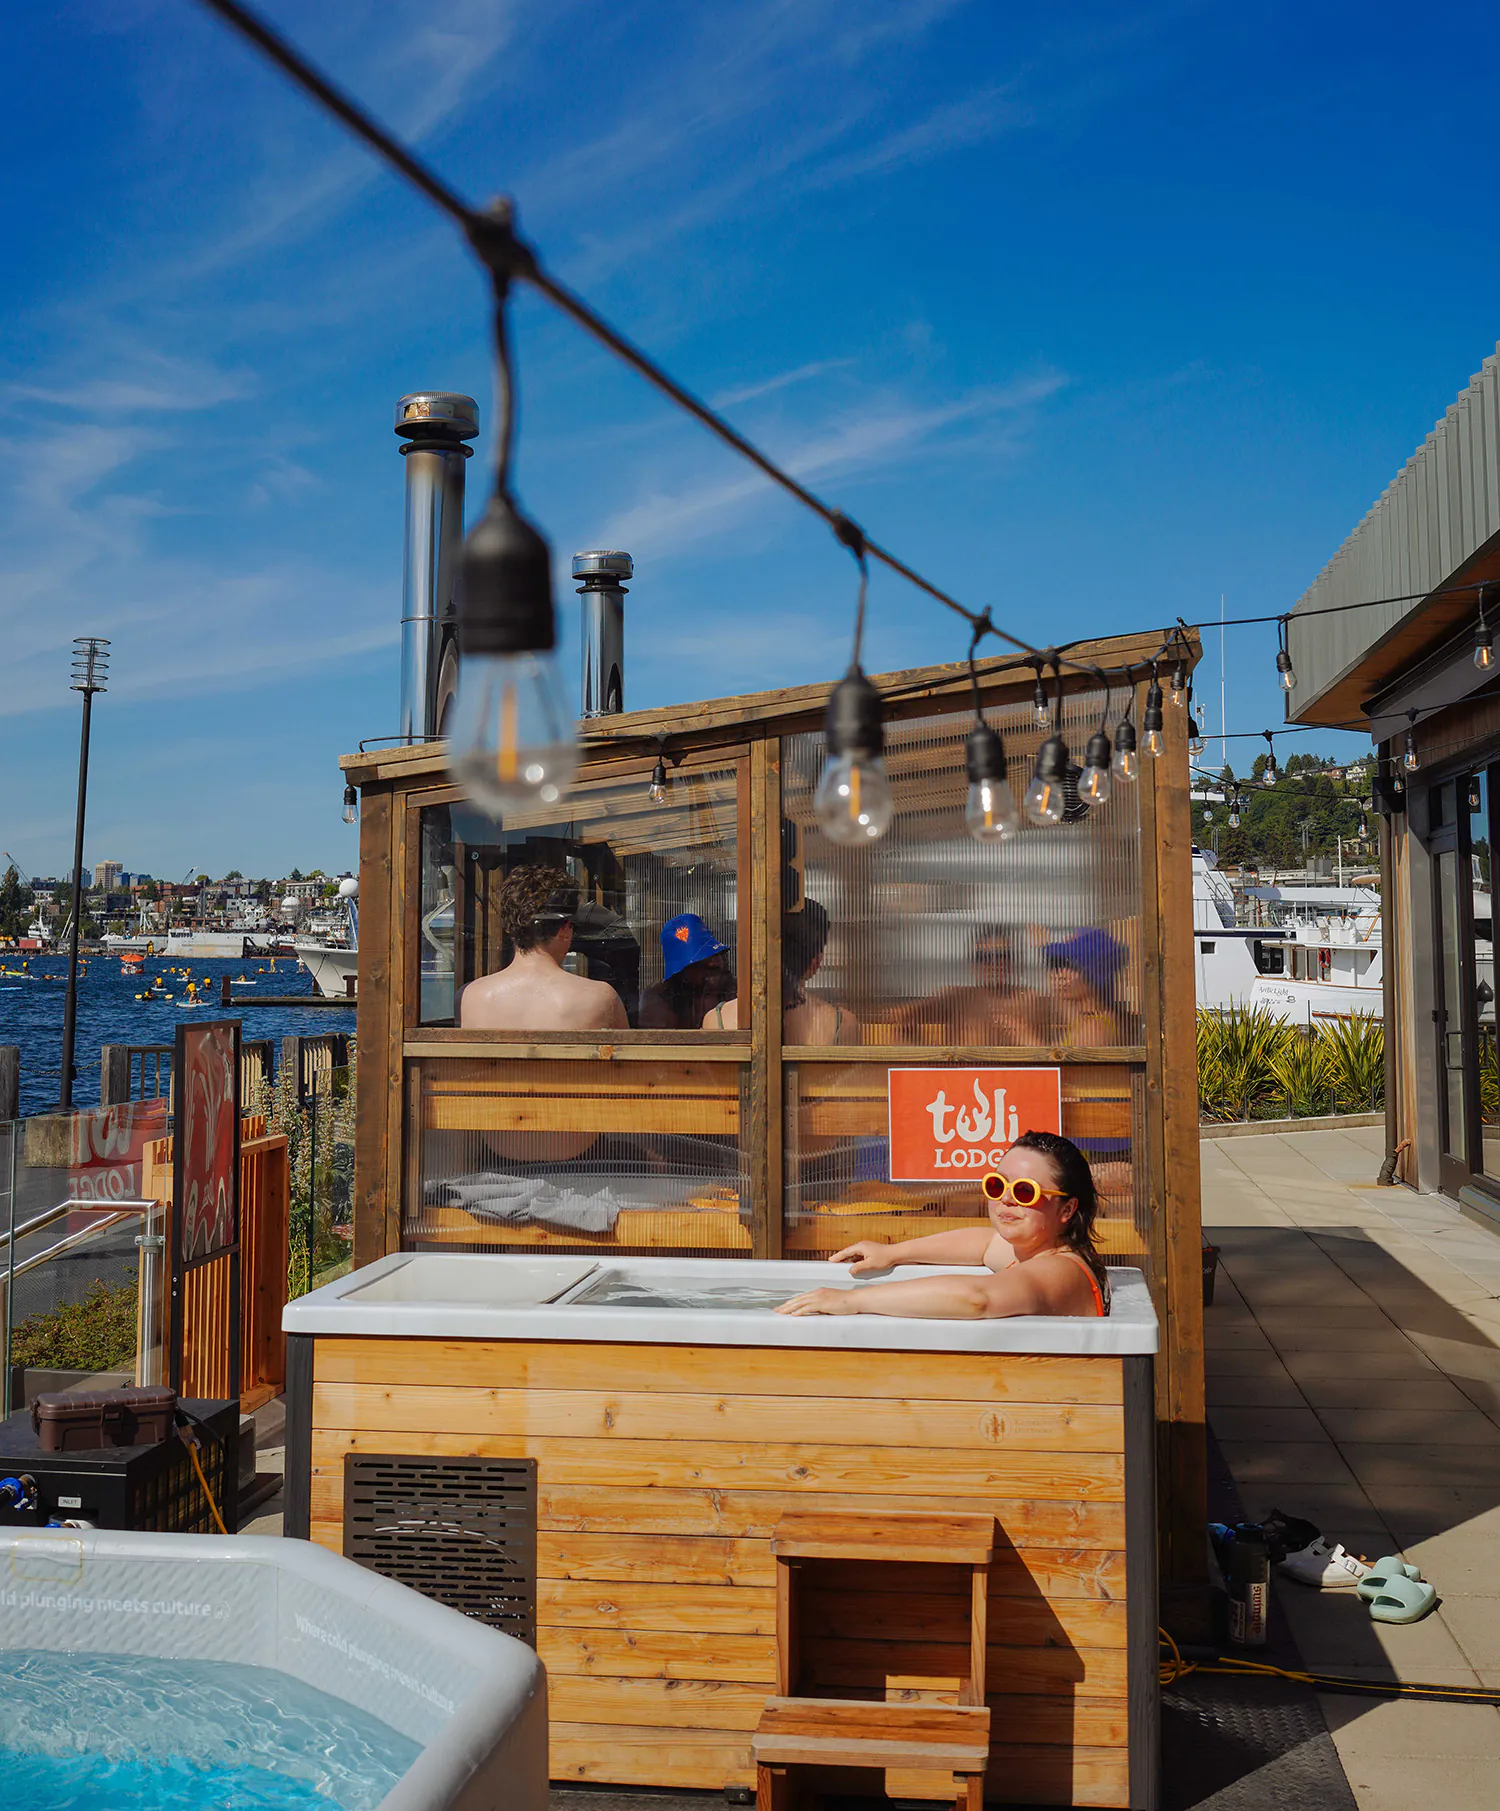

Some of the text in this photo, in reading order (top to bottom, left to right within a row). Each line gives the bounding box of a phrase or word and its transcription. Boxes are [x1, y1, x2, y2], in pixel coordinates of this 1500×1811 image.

[925, 1077, 1019, 1143] tuli
[934, 1148, 1008, 1168] LODG
[20, 1591, 93, 1613] plunging
[98, 1598, 149, 1613] meets
[152, 1600, 212, 1617] culture
[294, 1613, 327, 1643] Where
[348, 1642, 390, 1679] plunging
